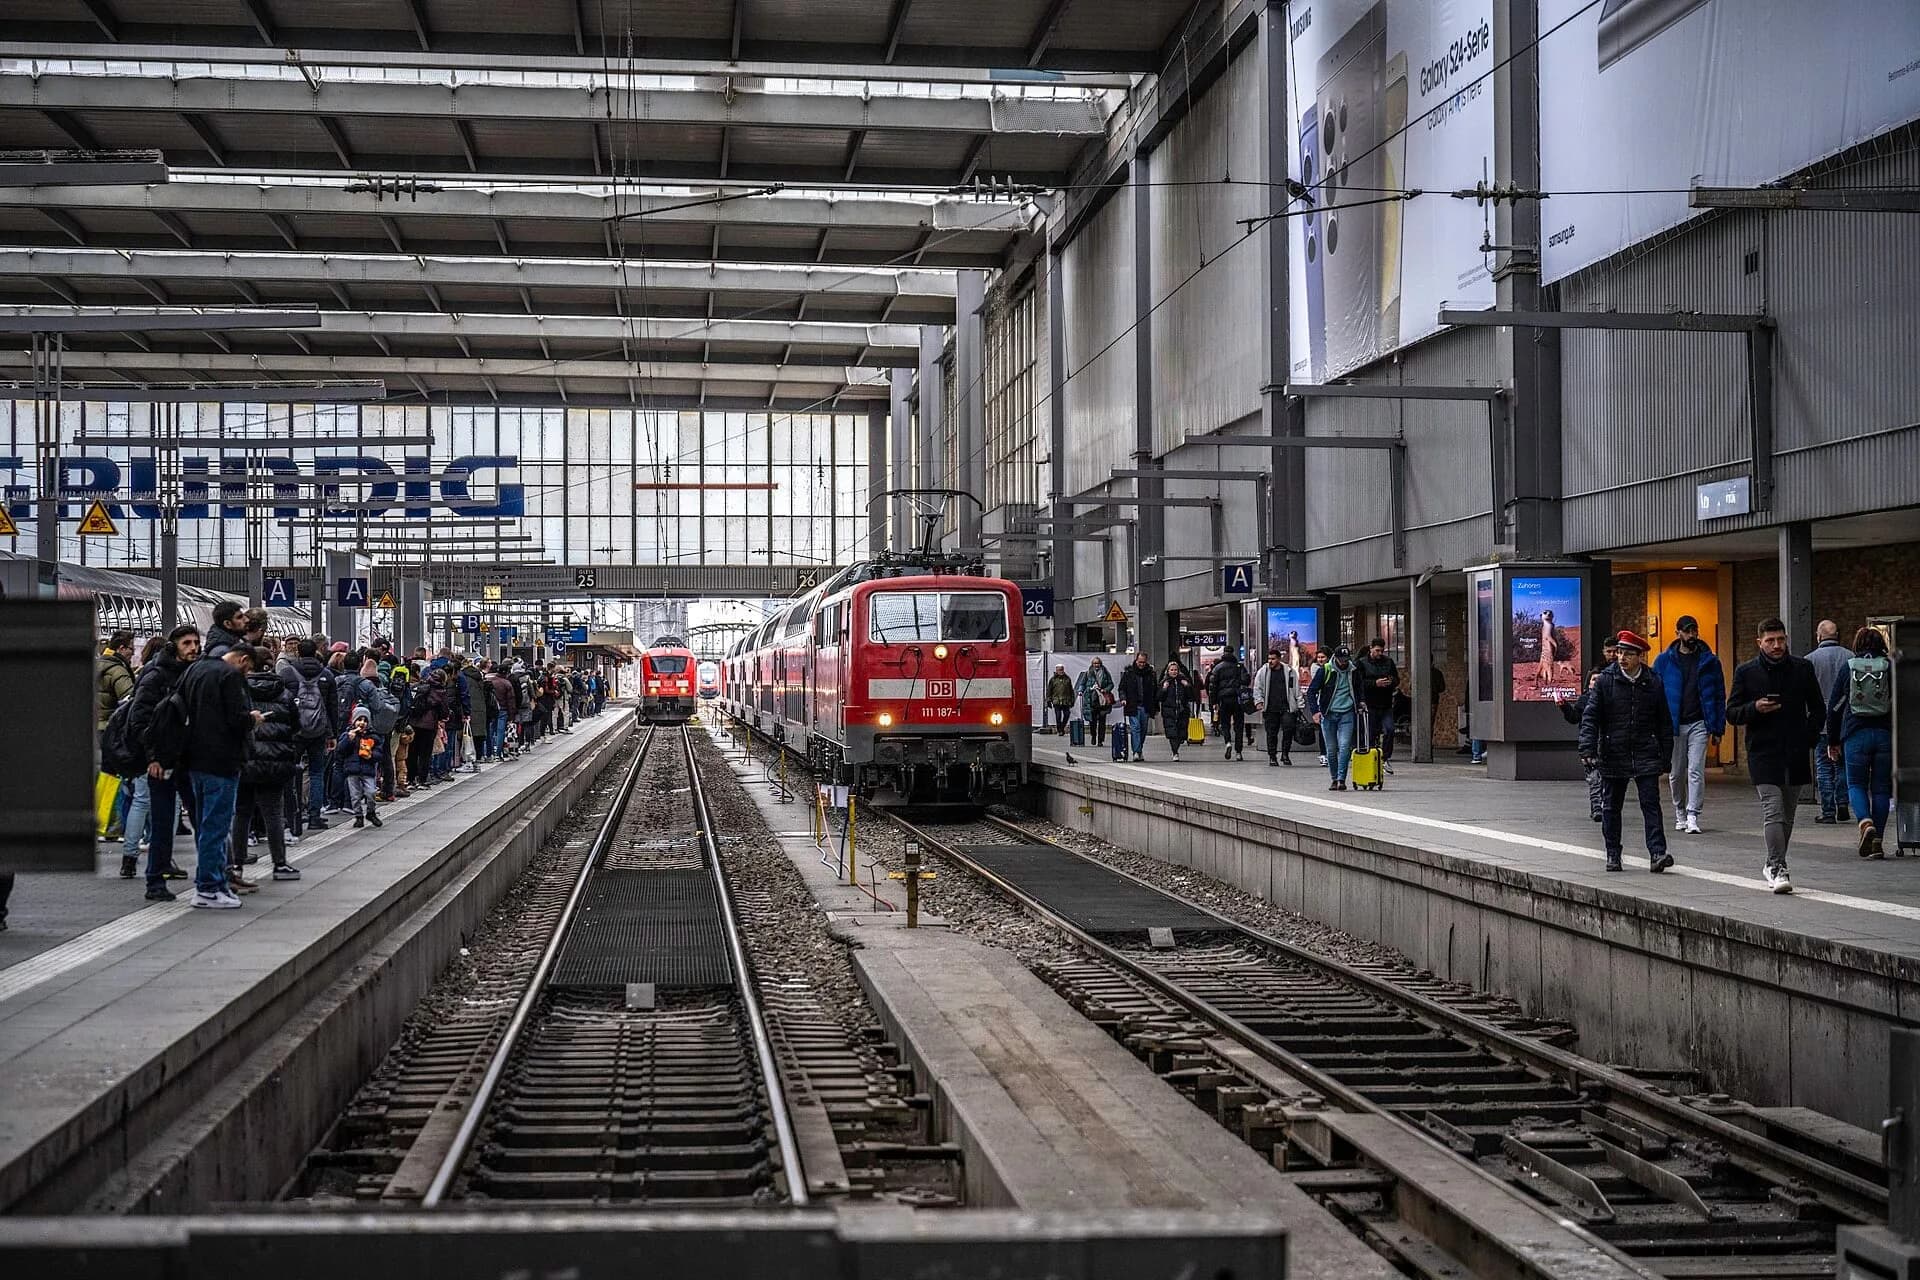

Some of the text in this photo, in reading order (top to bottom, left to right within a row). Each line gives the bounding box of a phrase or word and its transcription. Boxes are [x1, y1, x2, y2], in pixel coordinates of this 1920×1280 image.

[1290, 6, 1311, 42] AMSUNG
[1420, 17, 1489, 97] Galaxy S24-Serie
[578, 574, 594, 587] 25
[800, 574, 816, 587] 26
[1231, 566, 1249, 587] A
[269, 580, 287, 601] A
[346, 579, 364, 600] A
[1025, 600, 1045, 615] 26
[468, 615, 478, 629] B
[556, 640, 565, 651] C
[586, 651, 593, 660] D
[931, 683, 951, 696] DB
[922, 707, 933, 717] 111
